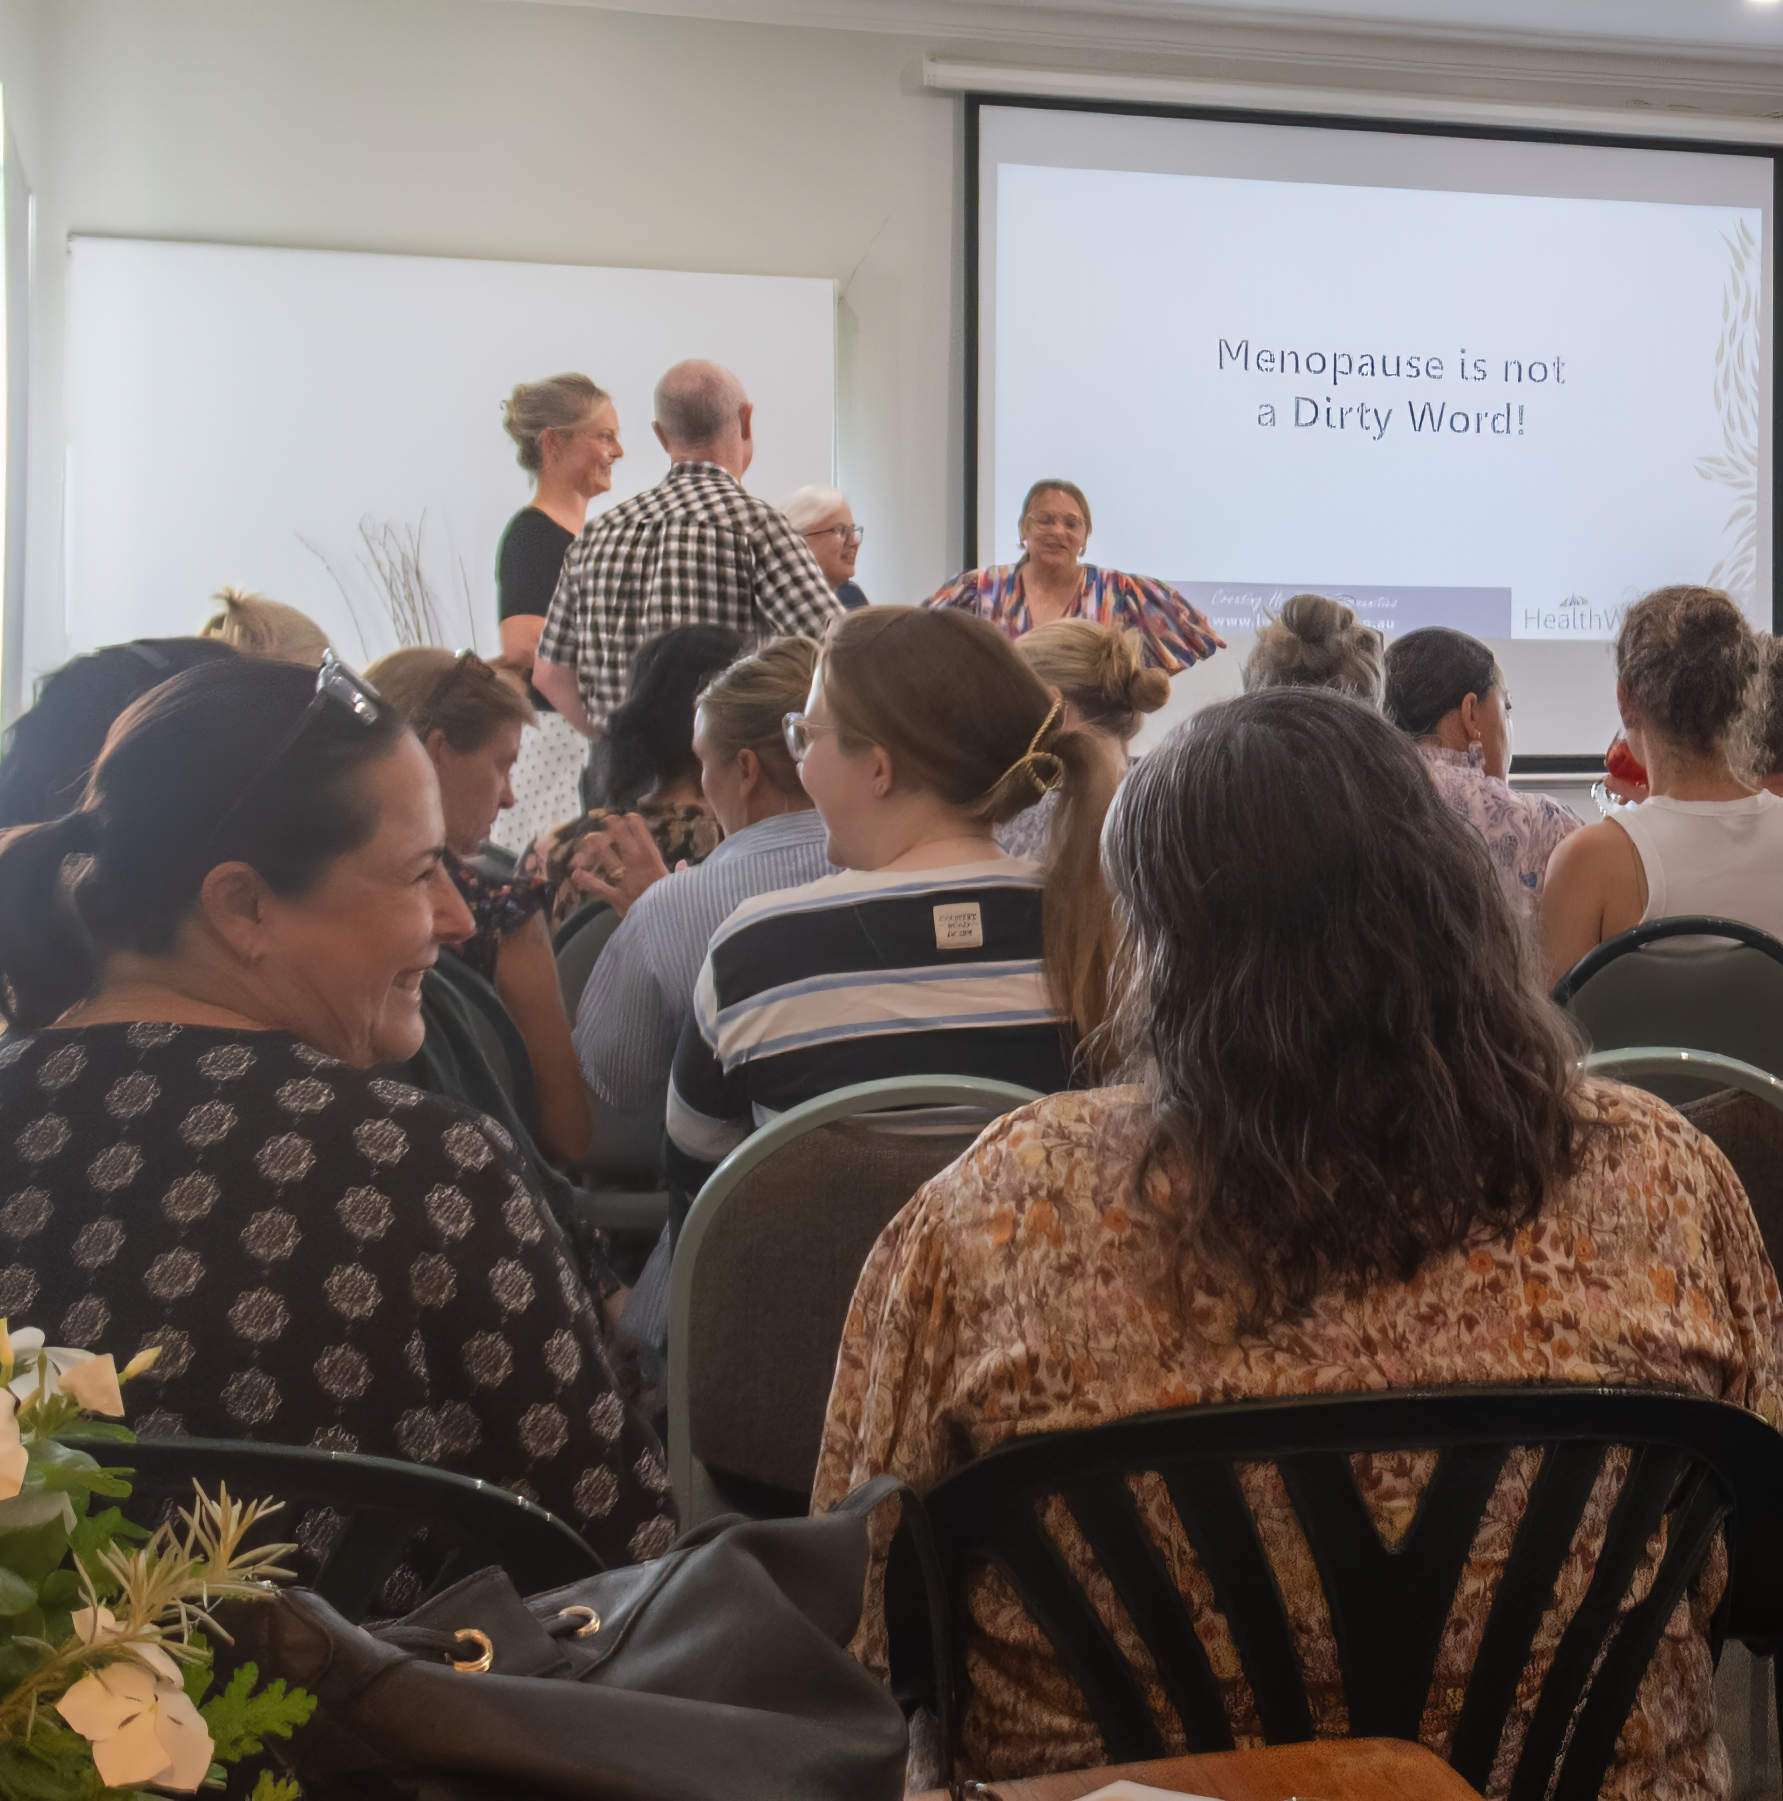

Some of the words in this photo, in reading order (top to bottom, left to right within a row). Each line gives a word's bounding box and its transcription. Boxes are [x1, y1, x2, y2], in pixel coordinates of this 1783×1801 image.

[1218, 338, 1445, 386] Menopause
[1459, 347, 1488, 382] is
[1503, 355, 1566, 384] not
[1257, 403, 1276, 428] a
[1294, 395, 1393, 441] Dirty
[1408, 400, 1525, 436] Word!
